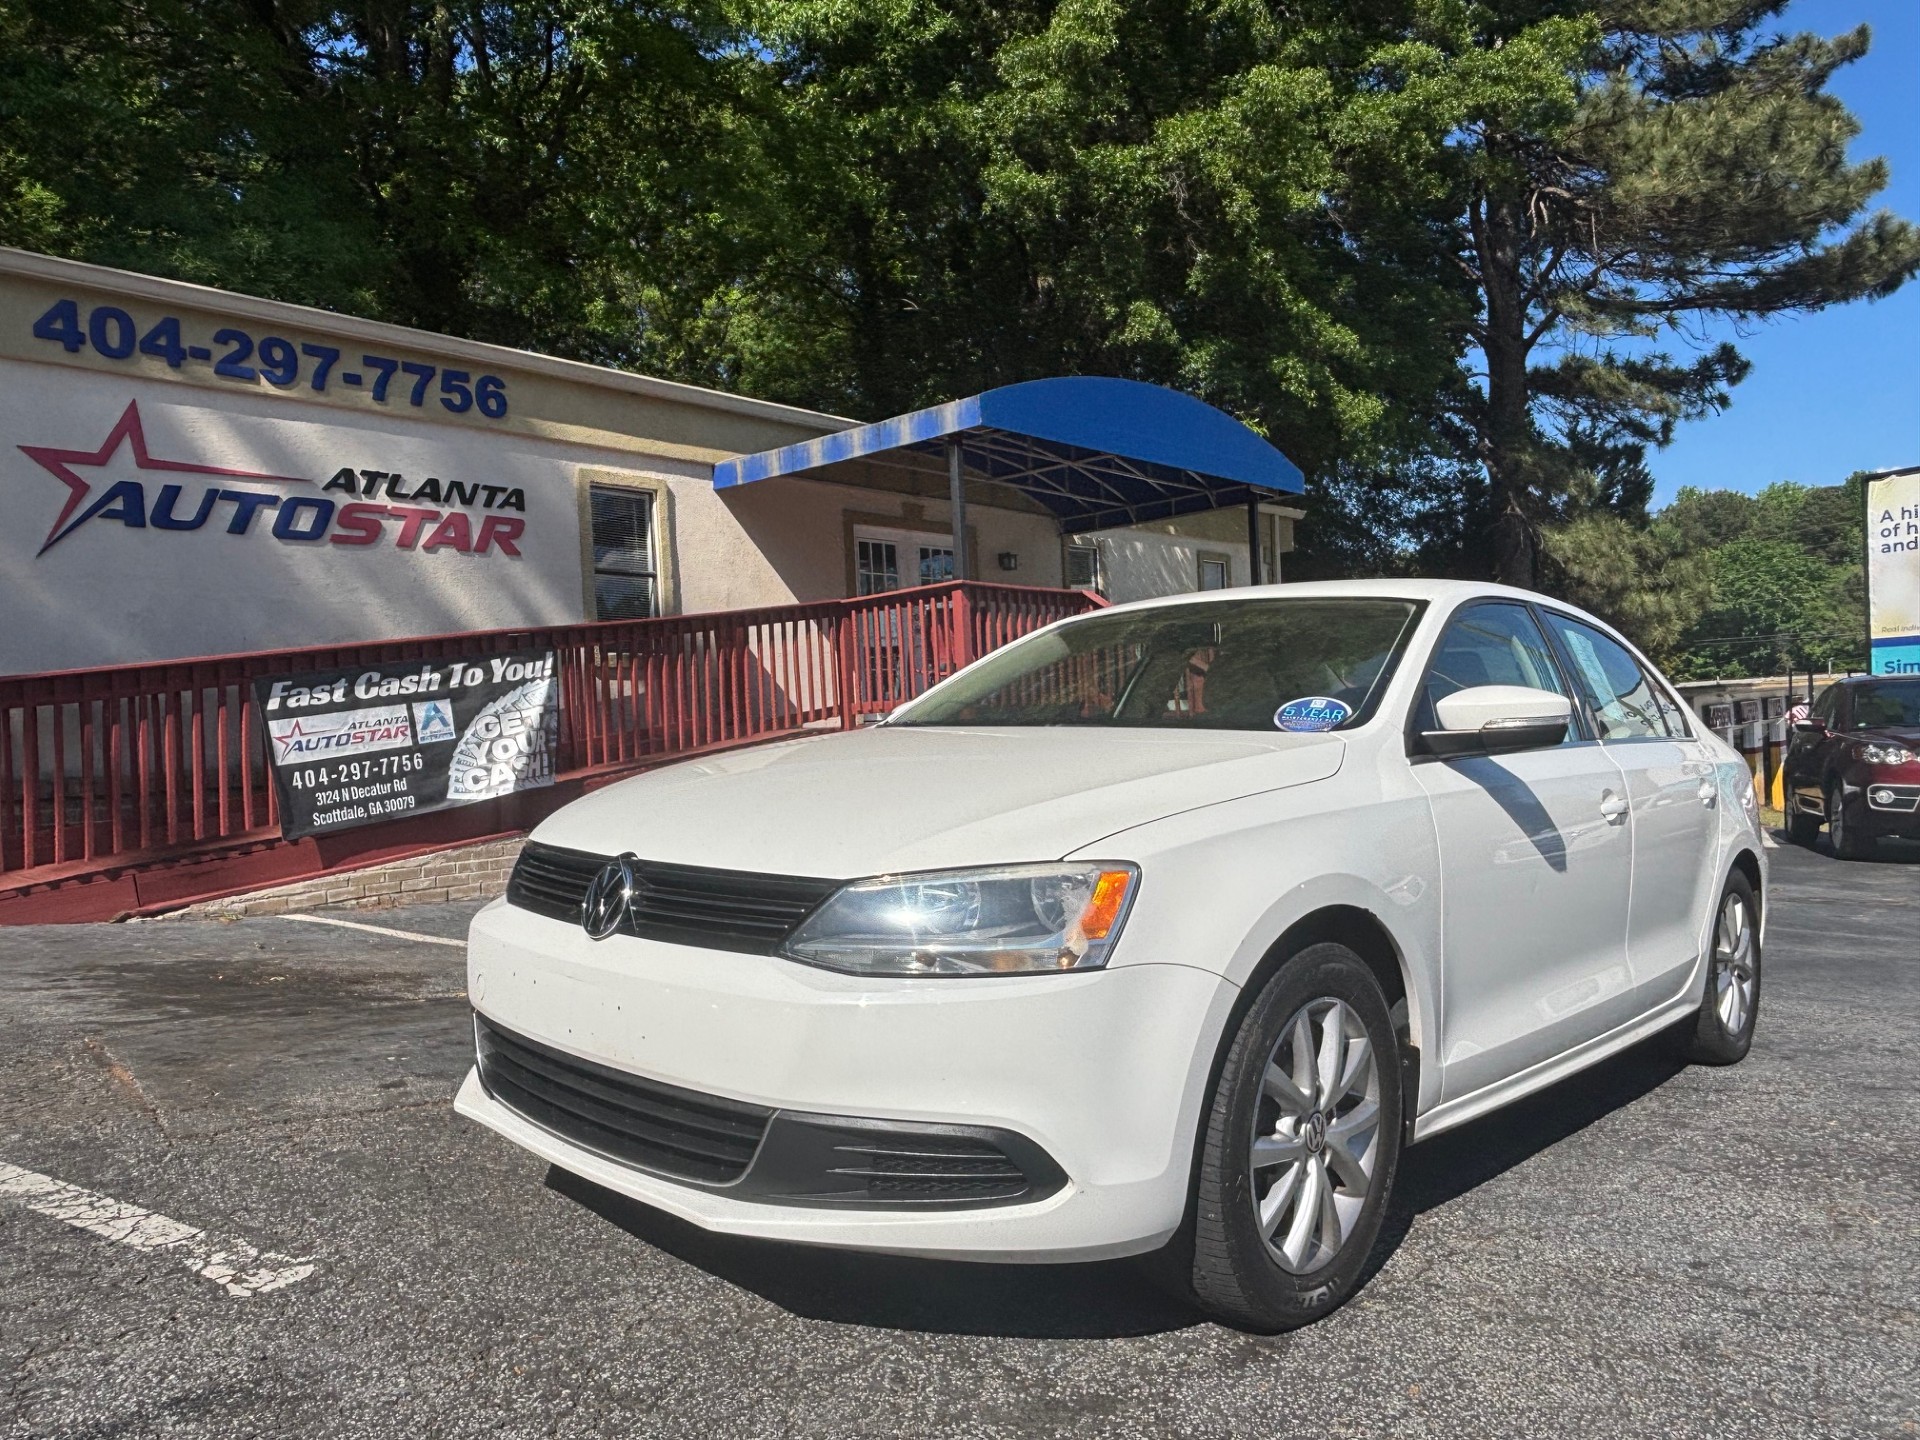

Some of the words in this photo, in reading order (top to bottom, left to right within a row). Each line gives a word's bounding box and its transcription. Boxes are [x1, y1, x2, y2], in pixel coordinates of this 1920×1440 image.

[33, 299, 508, 418] 404-297-7756
[322, 468, 525, 511] ATLANTA
[38, 481, 525, 558] AUTOSTAR
[1880, 510, 1894, 523] A
[1880, 523, 1900, 538] of
[1880, 536, 1919, 553] and
[267, 678, 348, 710] Fast
[354, 665, 441, 700] Cash
[448, 663, 484, 689] To
[490, 651, 553, 684] You!
[348, 715, 408, 730] ATLANTA
[475, 706, 544, 739] GET
[1283, 706, 1297, 716] 5
[1301, 707, 1344, 720] YEAR
[284, 725, 408, 757] AUTOSTAR
[466, 730, 546, 766] YOUR
[292, 753, 423, 789] 404-297-7756
[462, 753, 549, 791] CASH!
[315, 790, 340, 806] 3124
[341, 788, 349, 801] N
[351, 782, 391, 800] Decatur
[394, 778, 407, 792] Rd
[312, 805, 367, 826] Scottdale,
[369, 800, 383, 815] GA
[385, 795, 415, 812] 30079
